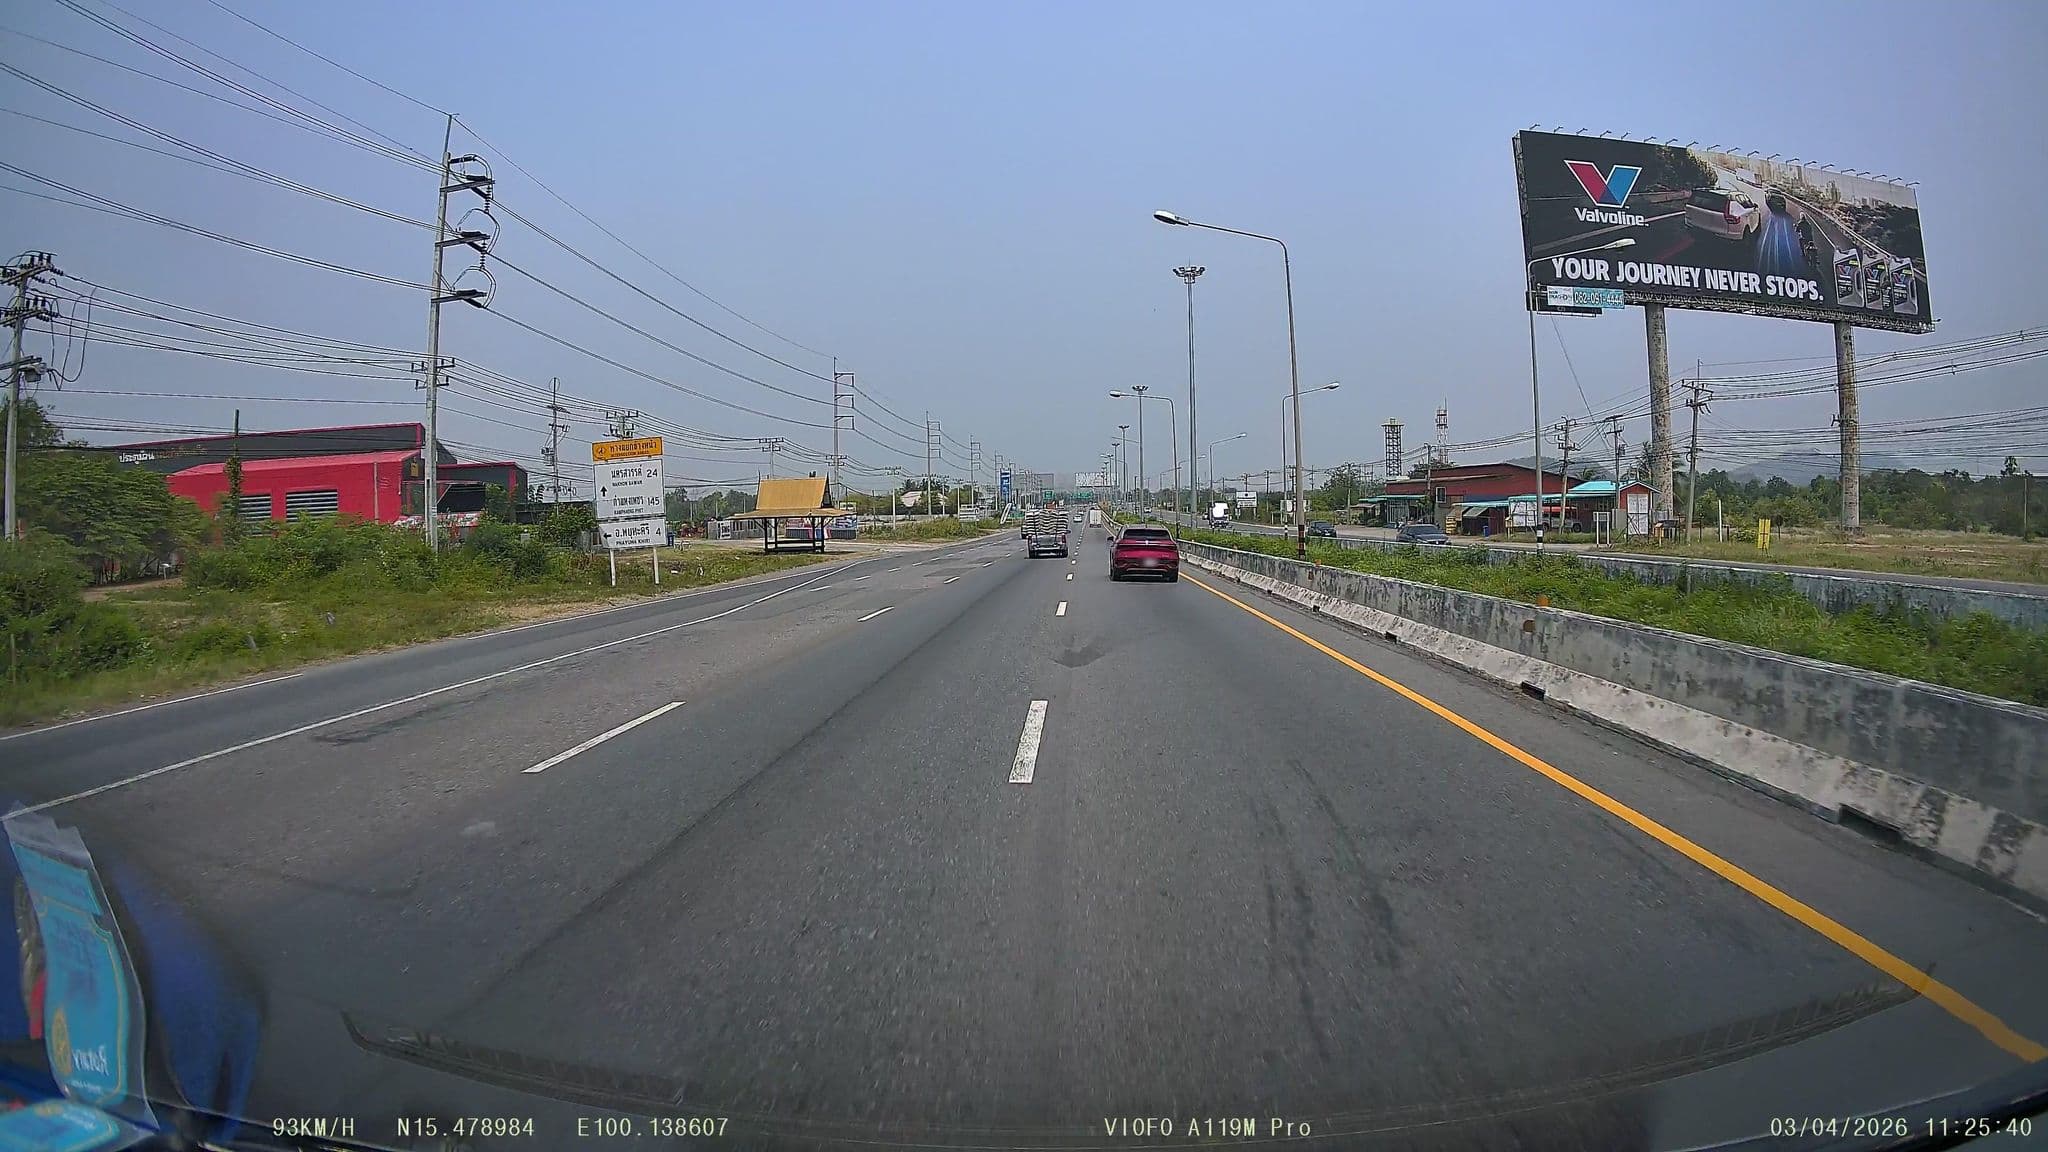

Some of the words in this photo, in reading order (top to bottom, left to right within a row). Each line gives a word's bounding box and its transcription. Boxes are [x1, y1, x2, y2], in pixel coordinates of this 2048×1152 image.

[1551, 257, 1611, 282] YOUR
[1616, 262, 1701, 288] JOURNEY
[1705, 269, 1760, 293] NEVER
[1765, 275, 1824, 302] STOPS.
[646, 469, 658, 478] 24
[647, 497, 660, 506] 145
[655, 527, 661, 536] 4
